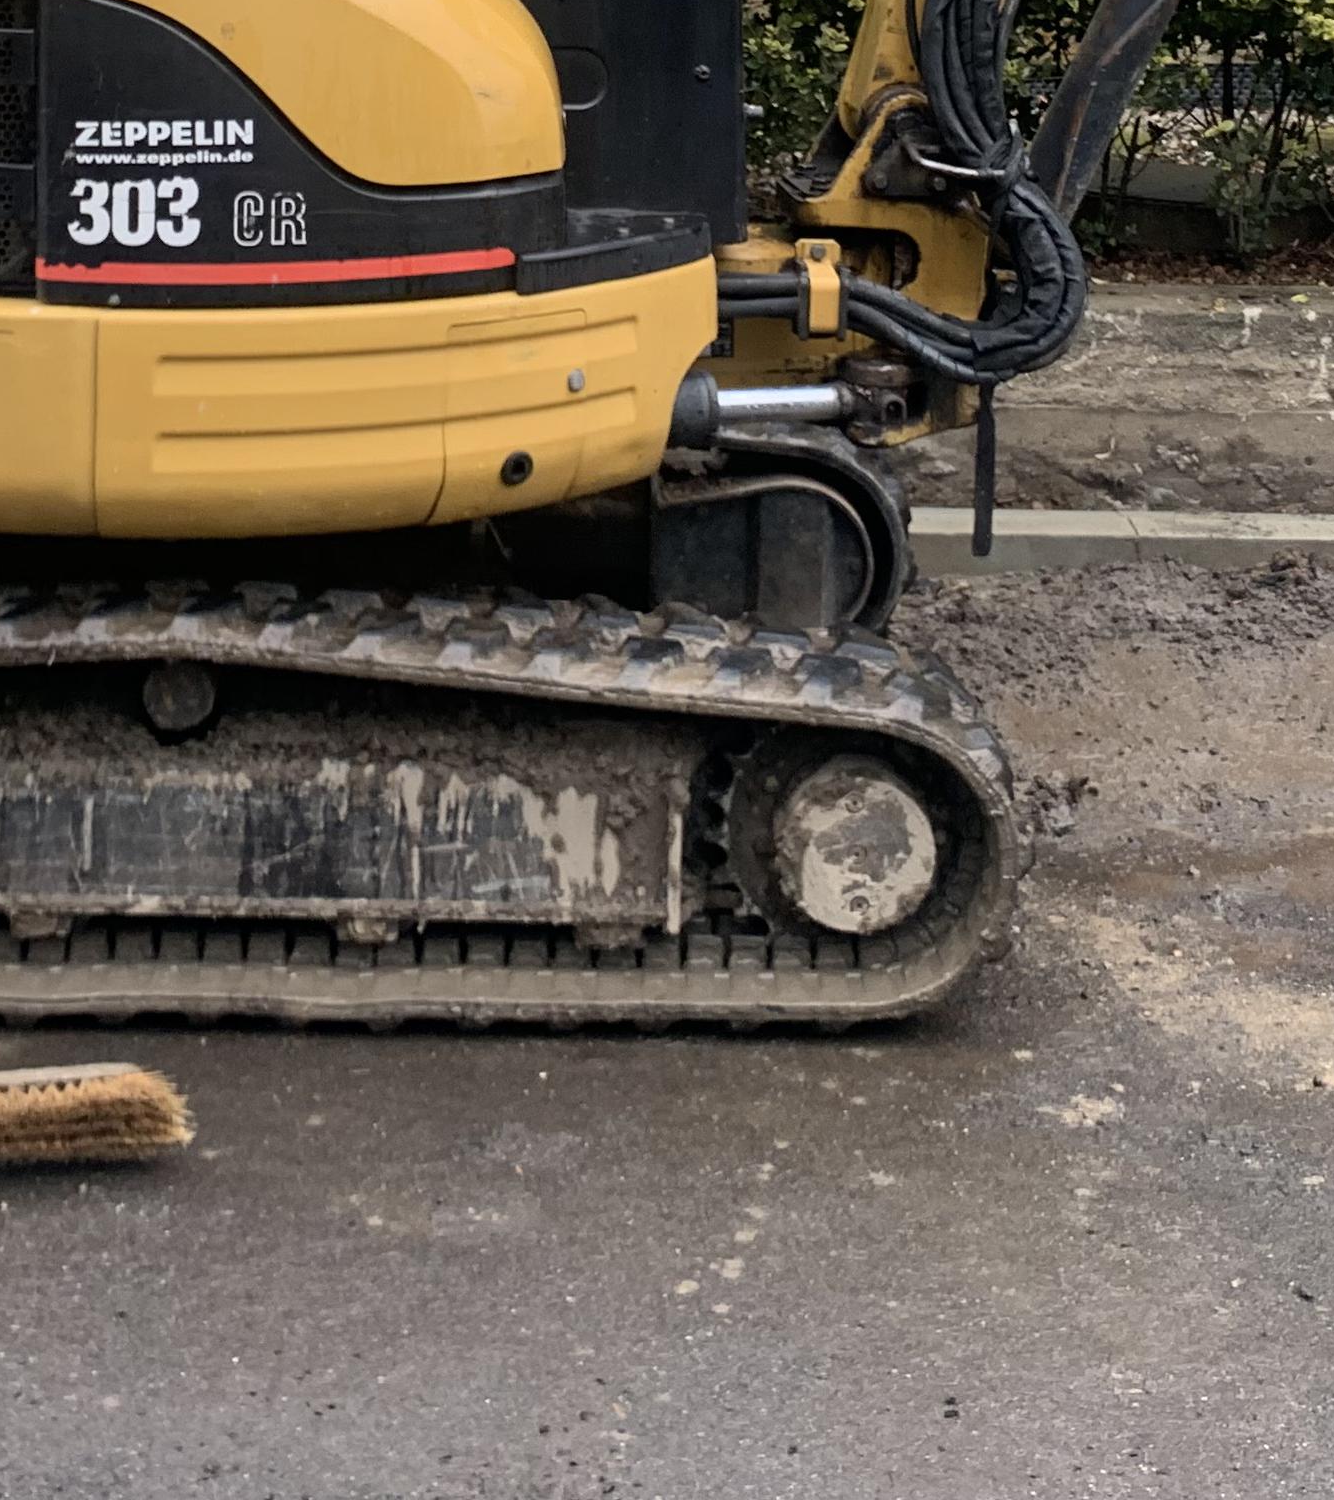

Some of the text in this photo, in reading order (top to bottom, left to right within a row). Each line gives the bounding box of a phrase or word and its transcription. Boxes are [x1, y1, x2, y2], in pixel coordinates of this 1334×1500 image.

[75, 119, 254, 148] ZEPPELIN
[75, 149, 254, 167] www.zeppelin.de
[68, 176, 307, 247] 303 CR
